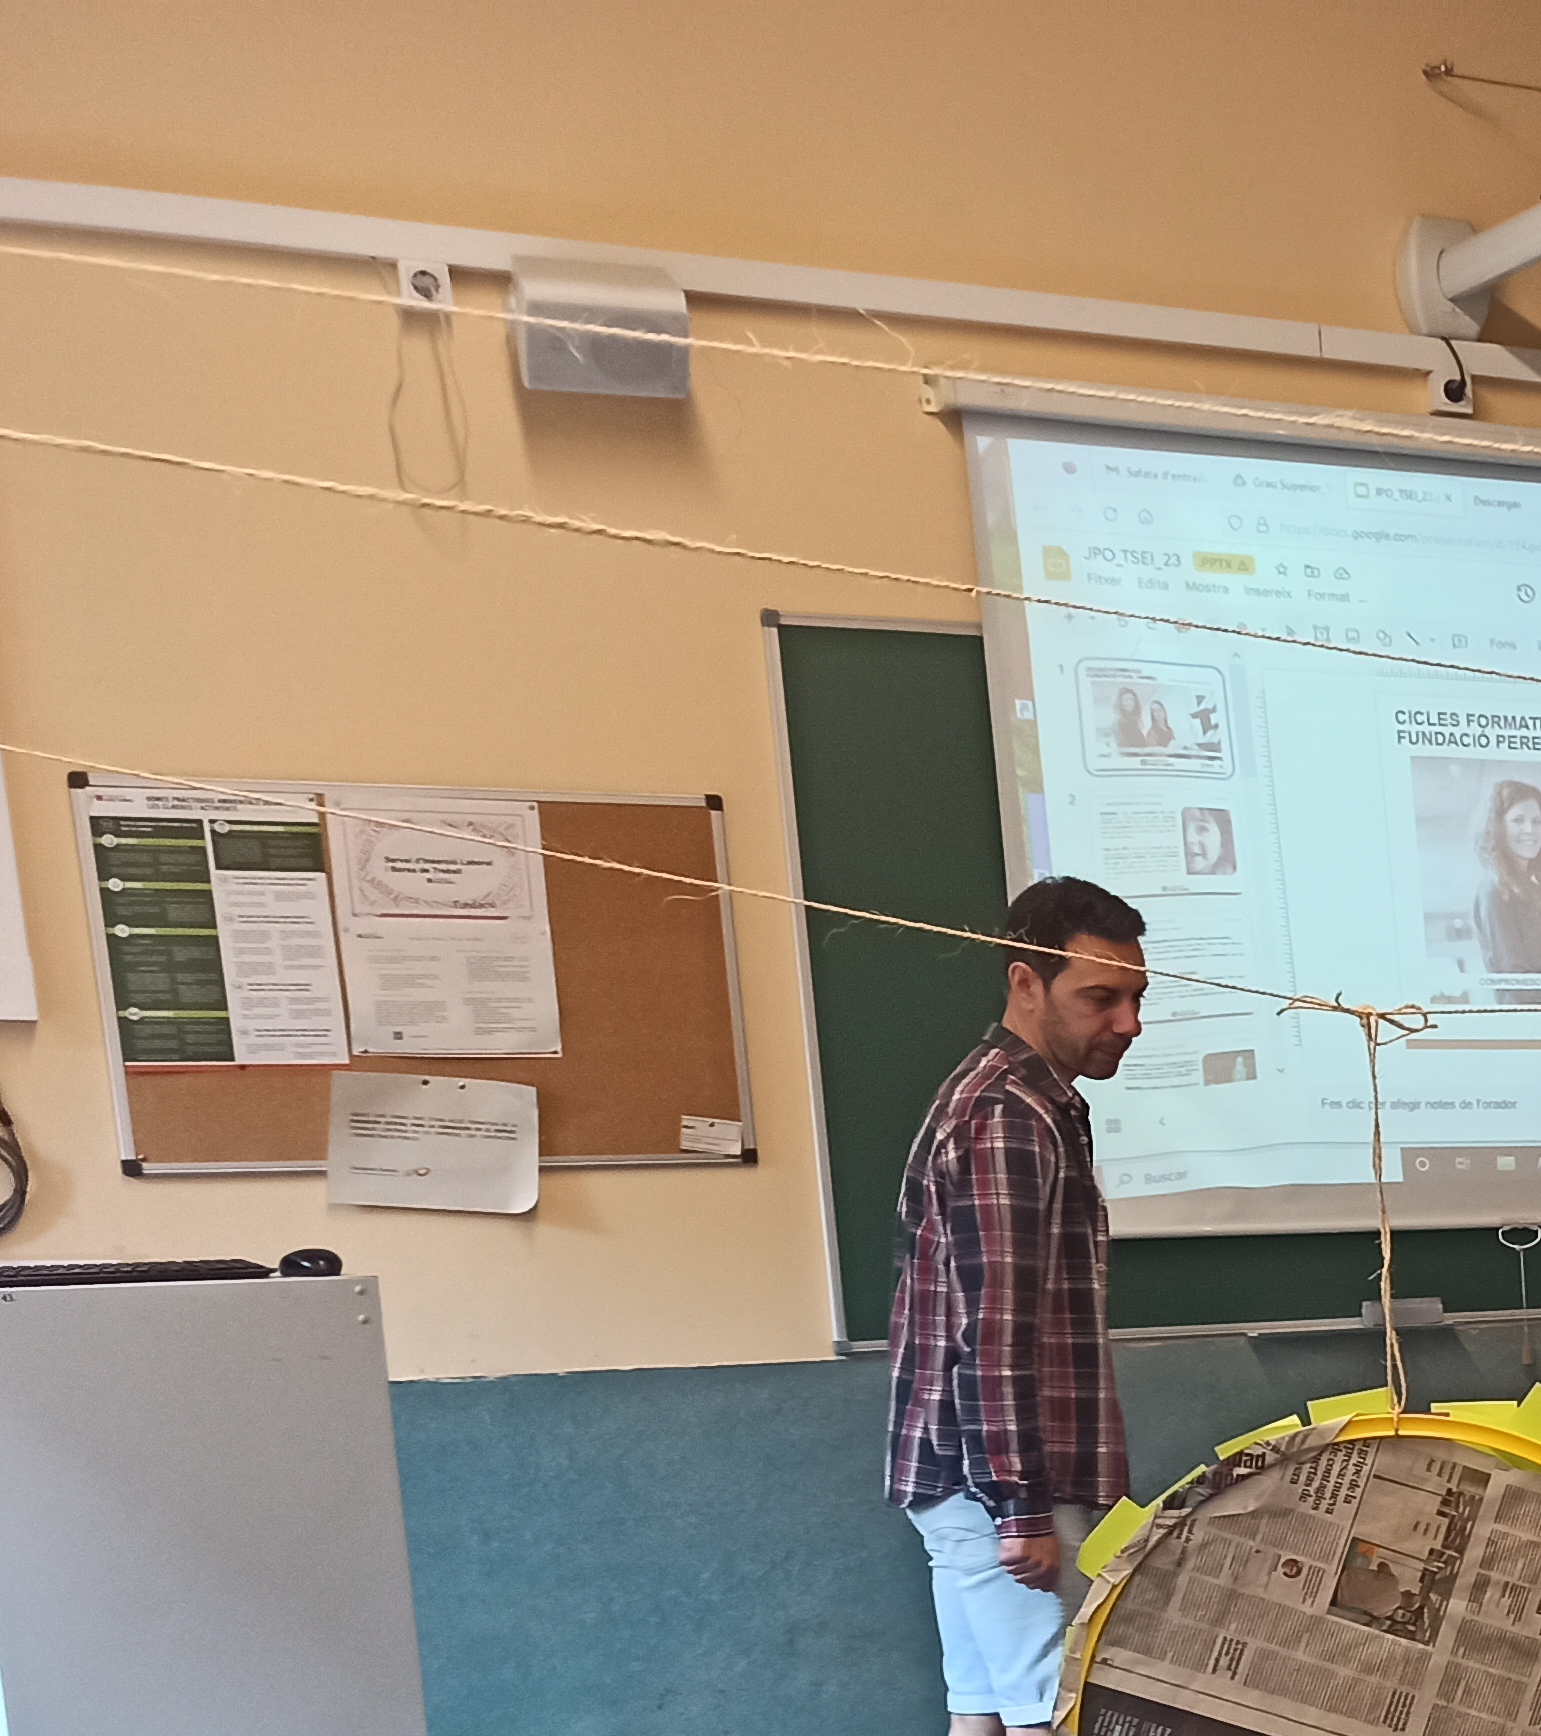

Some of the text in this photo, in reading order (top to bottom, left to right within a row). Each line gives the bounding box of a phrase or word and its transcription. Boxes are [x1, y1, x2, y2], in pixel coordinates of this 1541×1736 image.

[1185, 580, 1230, 595] Mostra
[1395, 710, 1460, 727] CICLES
[1397, 728, 1490, 749] FUNDACIÓ
[1496, 734, 1541, 751] PERE
[1346, 1478, 1361, 1494] de
